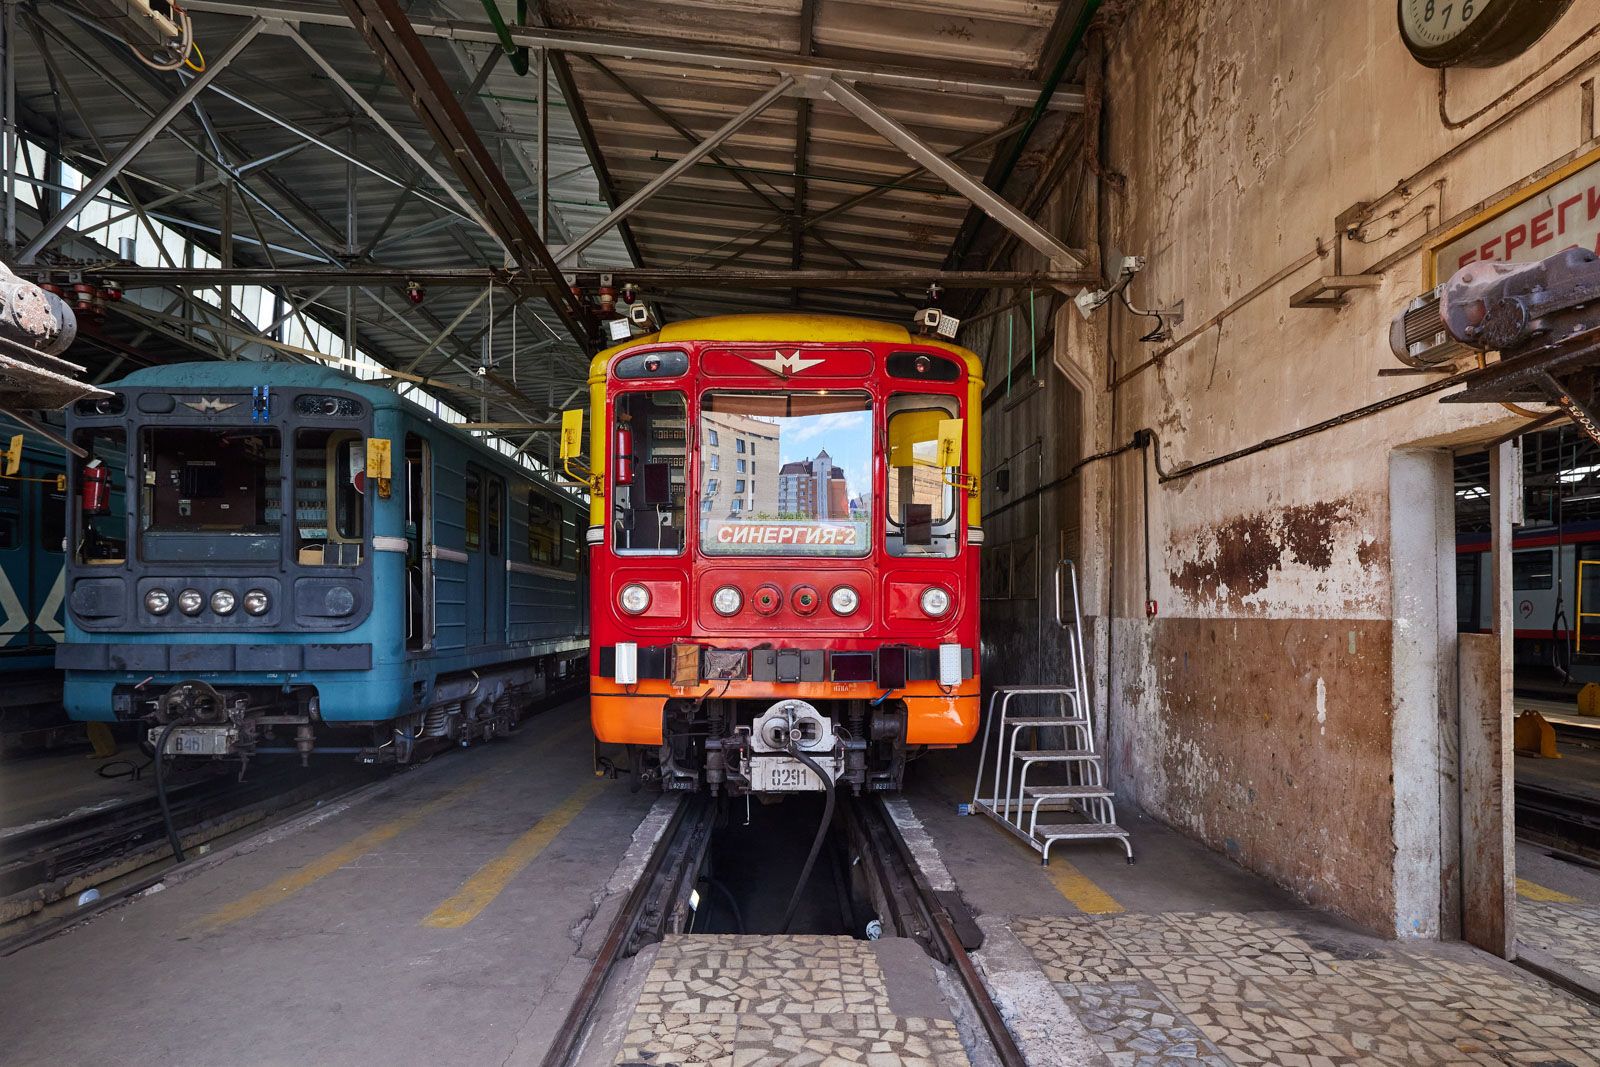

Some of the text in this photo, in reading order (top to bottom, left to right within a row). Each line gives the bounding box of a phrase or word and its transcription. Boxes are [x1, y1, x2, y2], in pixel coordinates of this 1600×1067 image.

[1424, 0, 1473, 30] 8 7 6
[717, 526, 856, 544] СИНЕРГИЯ-2
[772, 769, 807, 786] 0291
